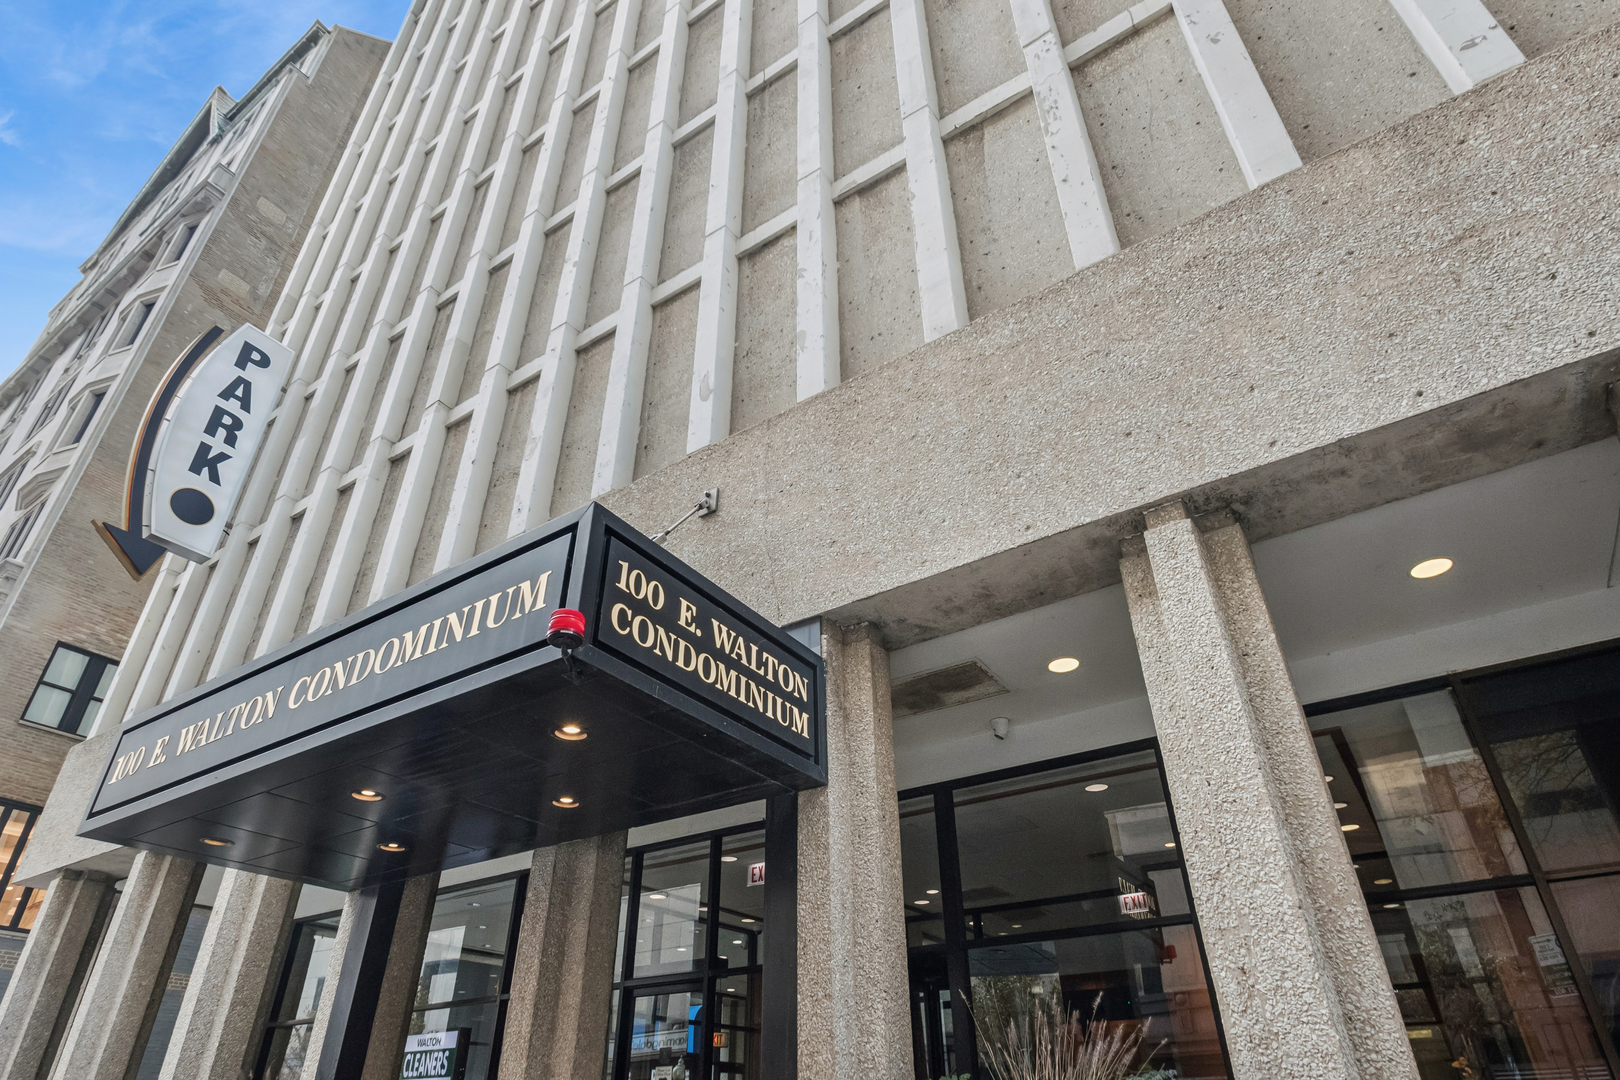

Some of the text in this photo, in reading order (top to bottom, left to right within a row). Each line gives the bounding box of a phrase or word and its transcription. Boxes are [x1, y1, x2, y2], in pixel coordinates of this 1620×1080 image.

[188, 340, 271, 487] PARK
[611, 602, 810, 739] CONDOMINIUM
[615, 559, 809, 702] 100 E. WALTON
[108, 570, 553, 785] 100 E. WALTON CONDOMINIUM
[751, 865, 764, 883] EX
[1123, 894, 1147, 911] EXIT
[403, 1050, 450, 1078] CLEANERS
[417, 1037, 442, 1048] WALTON
